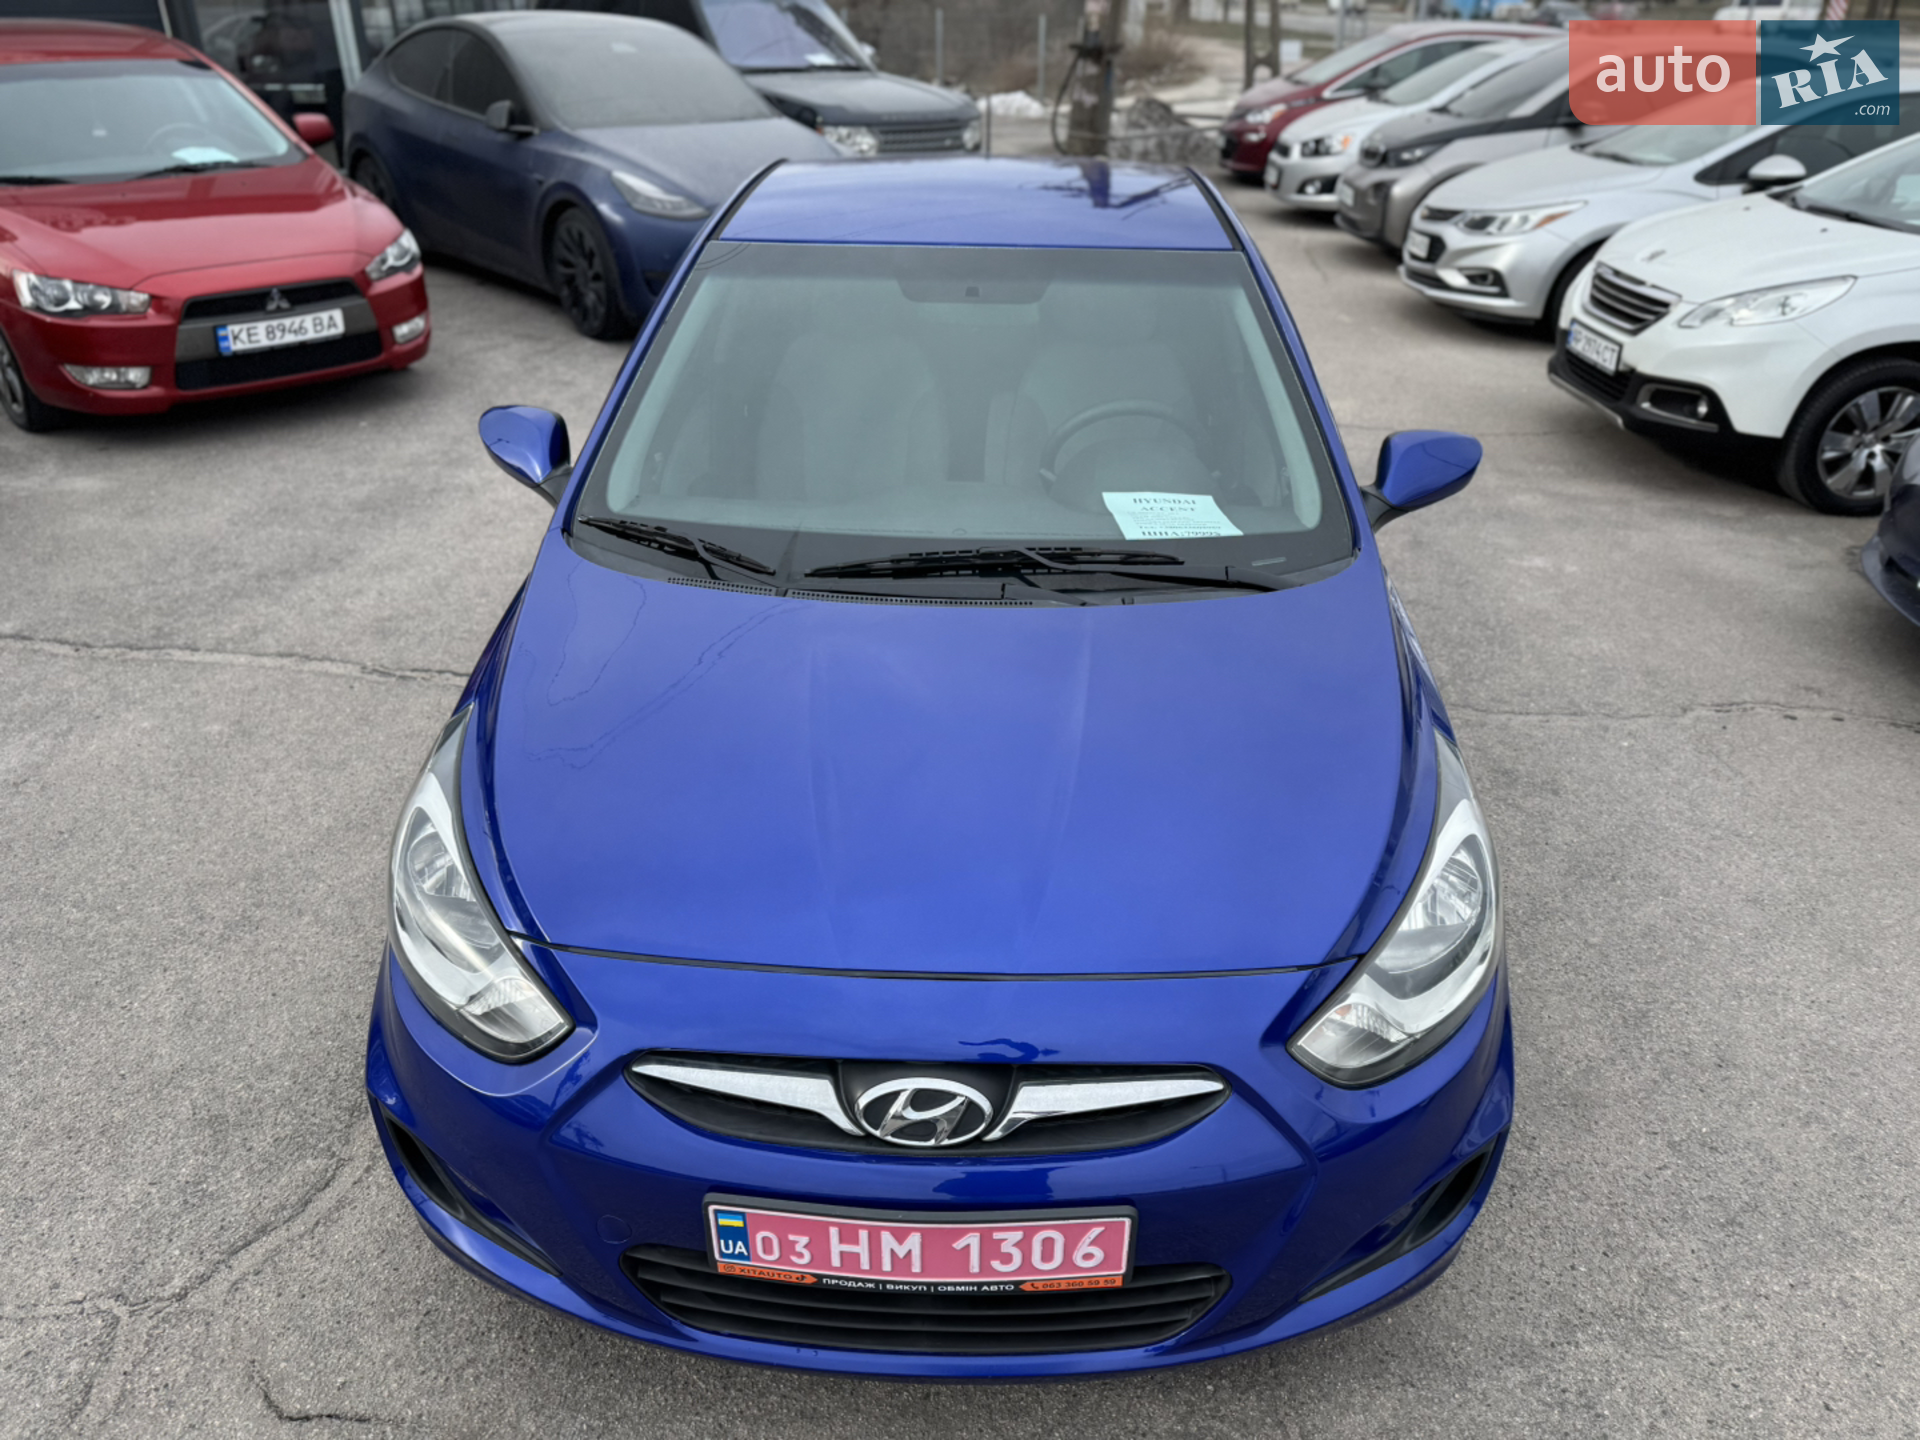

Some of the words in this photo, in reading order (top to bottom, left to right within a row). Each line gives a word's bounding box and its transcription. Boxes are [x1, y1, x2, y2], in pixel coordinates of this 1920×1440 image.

[230, 325, 261, 346] KE
[265, 318, 309, 342] 8946
[312, 314, 340, 335] BA
[719, 1239, 749, 1256] UA
[755, 1231, 812, 1265] 03
[829, 1226, 922, 1273] HM
[952, 1227, 1106, 1274] 1306
[822, 1278, 876, 1289] ПРОДАЖ
[886, 1284, 928, 1292] ВИКУП
[937, 1284, 978, 1292] ОБМІН
[981, 1284, 1015, 1292] АВТО
